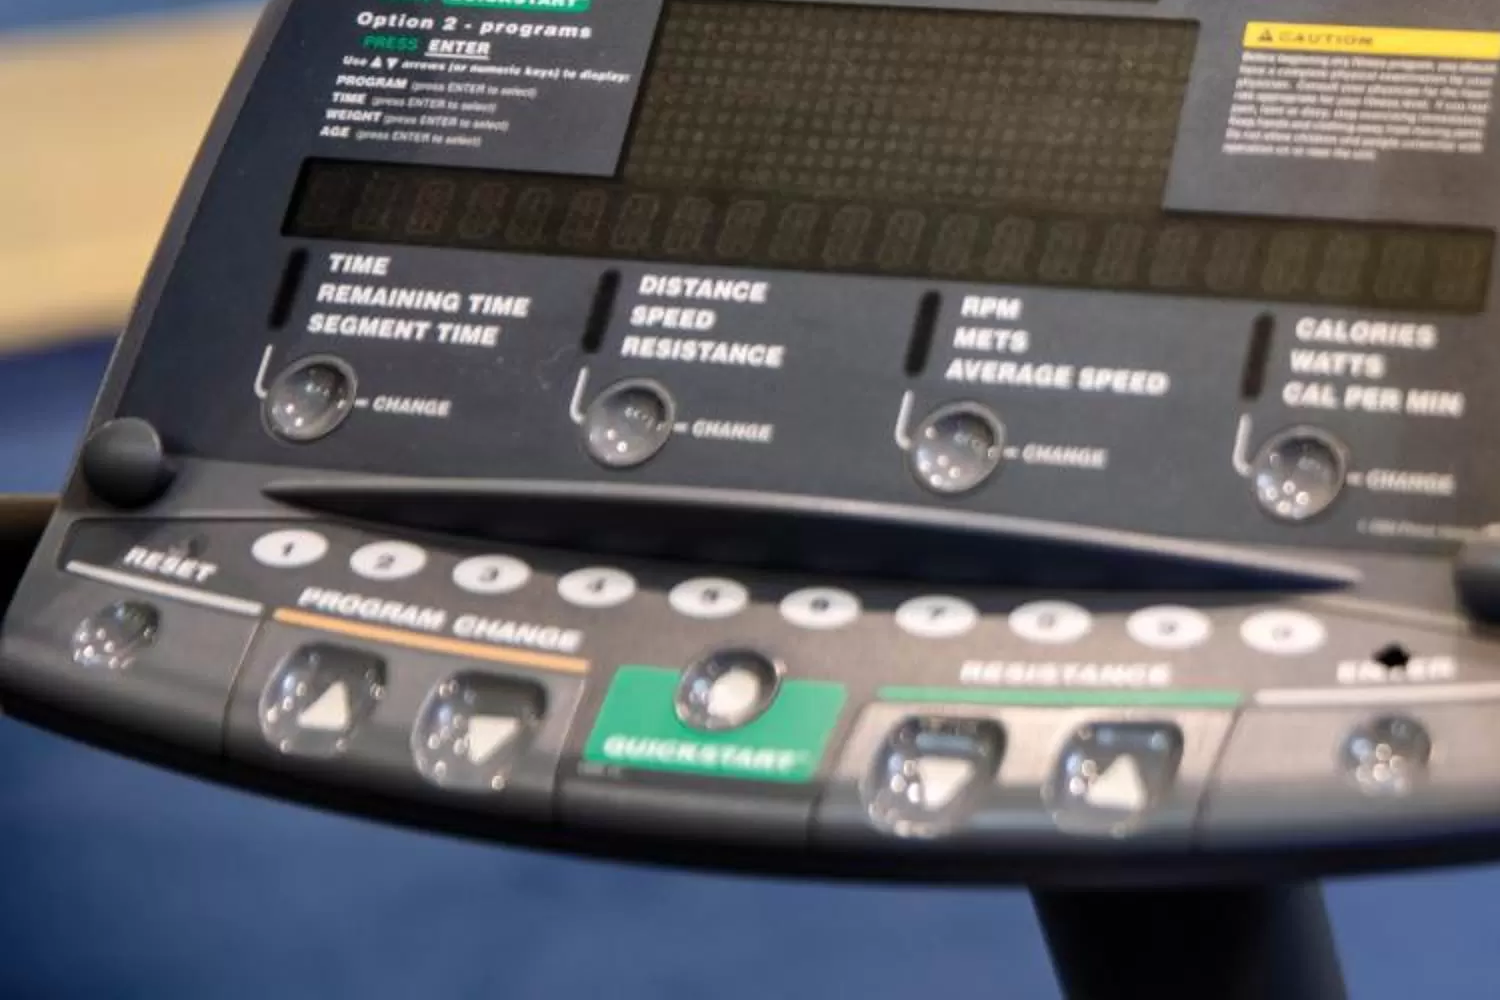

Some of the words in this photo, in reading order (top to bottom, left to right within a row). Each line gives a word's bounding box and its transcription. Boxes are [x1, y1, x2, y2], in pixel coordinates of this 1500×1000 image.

[356, 11, 435, 31] Option
[441, 16, 459, 32] 2
[479, 19, 593, 39] programs
[1279, 30, 1373, 46] CAUTION
[362, 34, 419, 51] PRESS
[427, 38, 491, 56] ENTER
[342, 55, 369, 67] Use
[401, 59, 446, 71] arrows
[335, 74, 409, 89] PROGRAM
[447, 81, 486, 95] ENTER
[331, 91, 368, 105] TIME
[407, 96, 447, 109] ENTER
[325, 108, 383, 122] WEIGHT
[419, 114, 459, 127] ENTER
[319, 124, 351, 139] AGE
[391, 130, 432, 143] ENTER
[328, 252, 392, 276] TIME
[316, 282, 463, 313] REMAINING
[468, 293, 532, 318] TIME
[638, 274, 770, 303] DISTANCE
[629, 304, 717, 331] SPEED
[961, 295, 1023, 321] RPM
[306, 312, 432, 341] SEGMENT
[436, 323, 500, 347] TIME
[952, 325, 1030, 354] METS
[1295, 316, 1439, 349] CALORIES
[620, 335, 786, 369] RESISTANCE
[1289, 347, 1387, 380] WATTS
[944, 357, 1077, 389] AVERAGE
[1077, 365, 1170, 397] SPEED
[372, 395, 453, 418] CHANGE
[1282, 380, 1338, 410] CAL
[1343, 384, 1404, 413] PER
[1404, 387, 1466, 419] MIN
[691, 418, 774, 443] CHANGE
[1022, 443, 1110, 470] CHANGE
[1364, 467, 1457, 497] CHANGE
[123, 544, 218, 582] RESET
[298, 586, 448, 632] PROGRAM
[452, 613, 585, 654] CHANGE
[960, 659, 1172, 687] RESISTANCE
